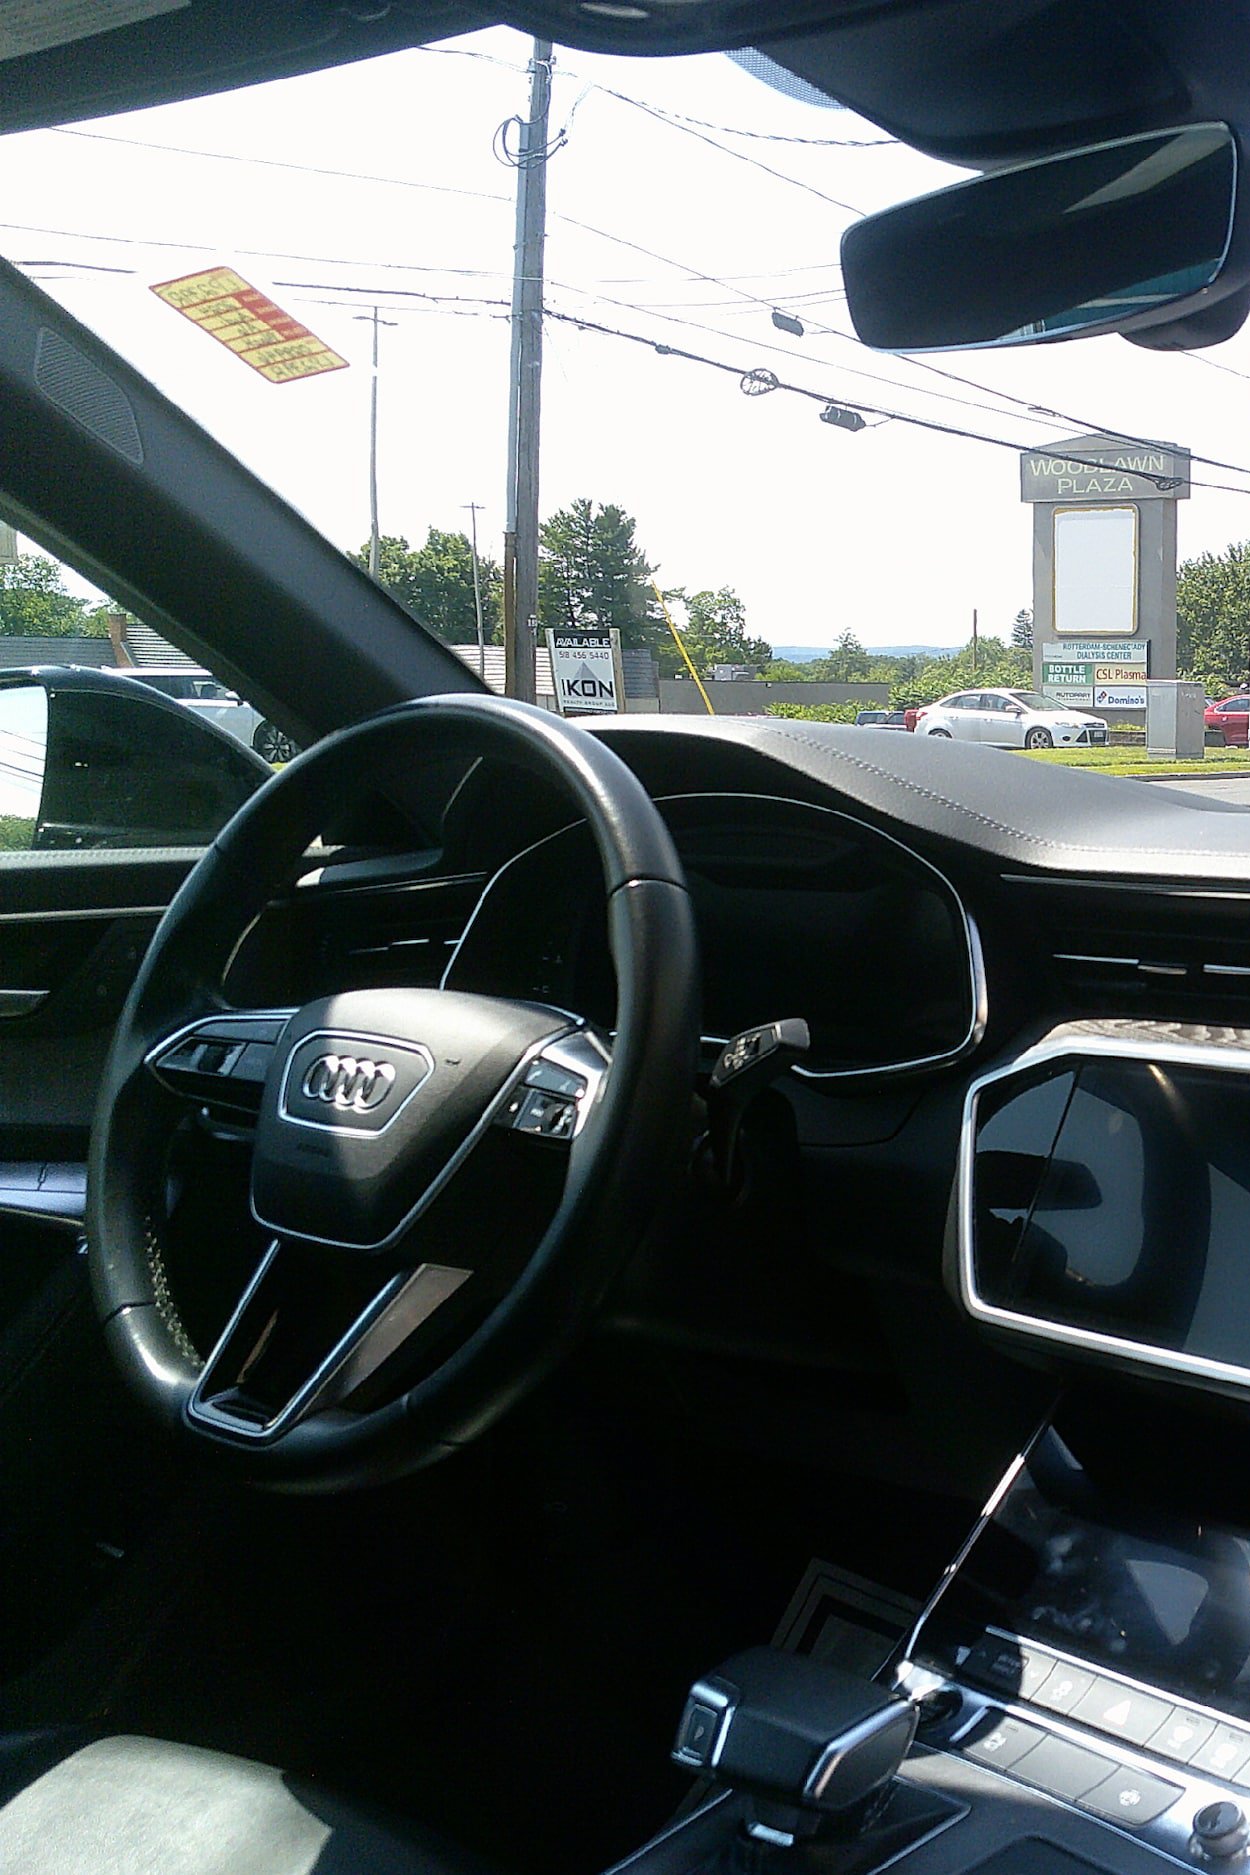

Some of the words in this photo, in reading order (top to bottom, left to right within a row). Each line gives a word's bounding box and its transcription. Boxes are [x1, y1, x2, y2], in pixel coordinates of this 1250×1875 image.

[1030, 456, 1164, 475] WOODLAWN
[1057, 477, 1133, 495] PLAZA
[556, 638, 610, 647] AVAILABLE
[573, 652, 587, 660] 456
[590, 652, 609, 660] 5440
[1076, 651, 1105, 660] DIALYSIS
[1107, 651, 1132, 660] CENTER
[1049, 665, 1086, 674] BOTTLE
[1048, 674, 1086, 684] RETURN
[1096, 669, 1112, 680] CSL
[1115, 669, 1146, 680] Plasma
[561, 679, 614, 698] IKON
[1108, 696, 1144, 705] Domino's
